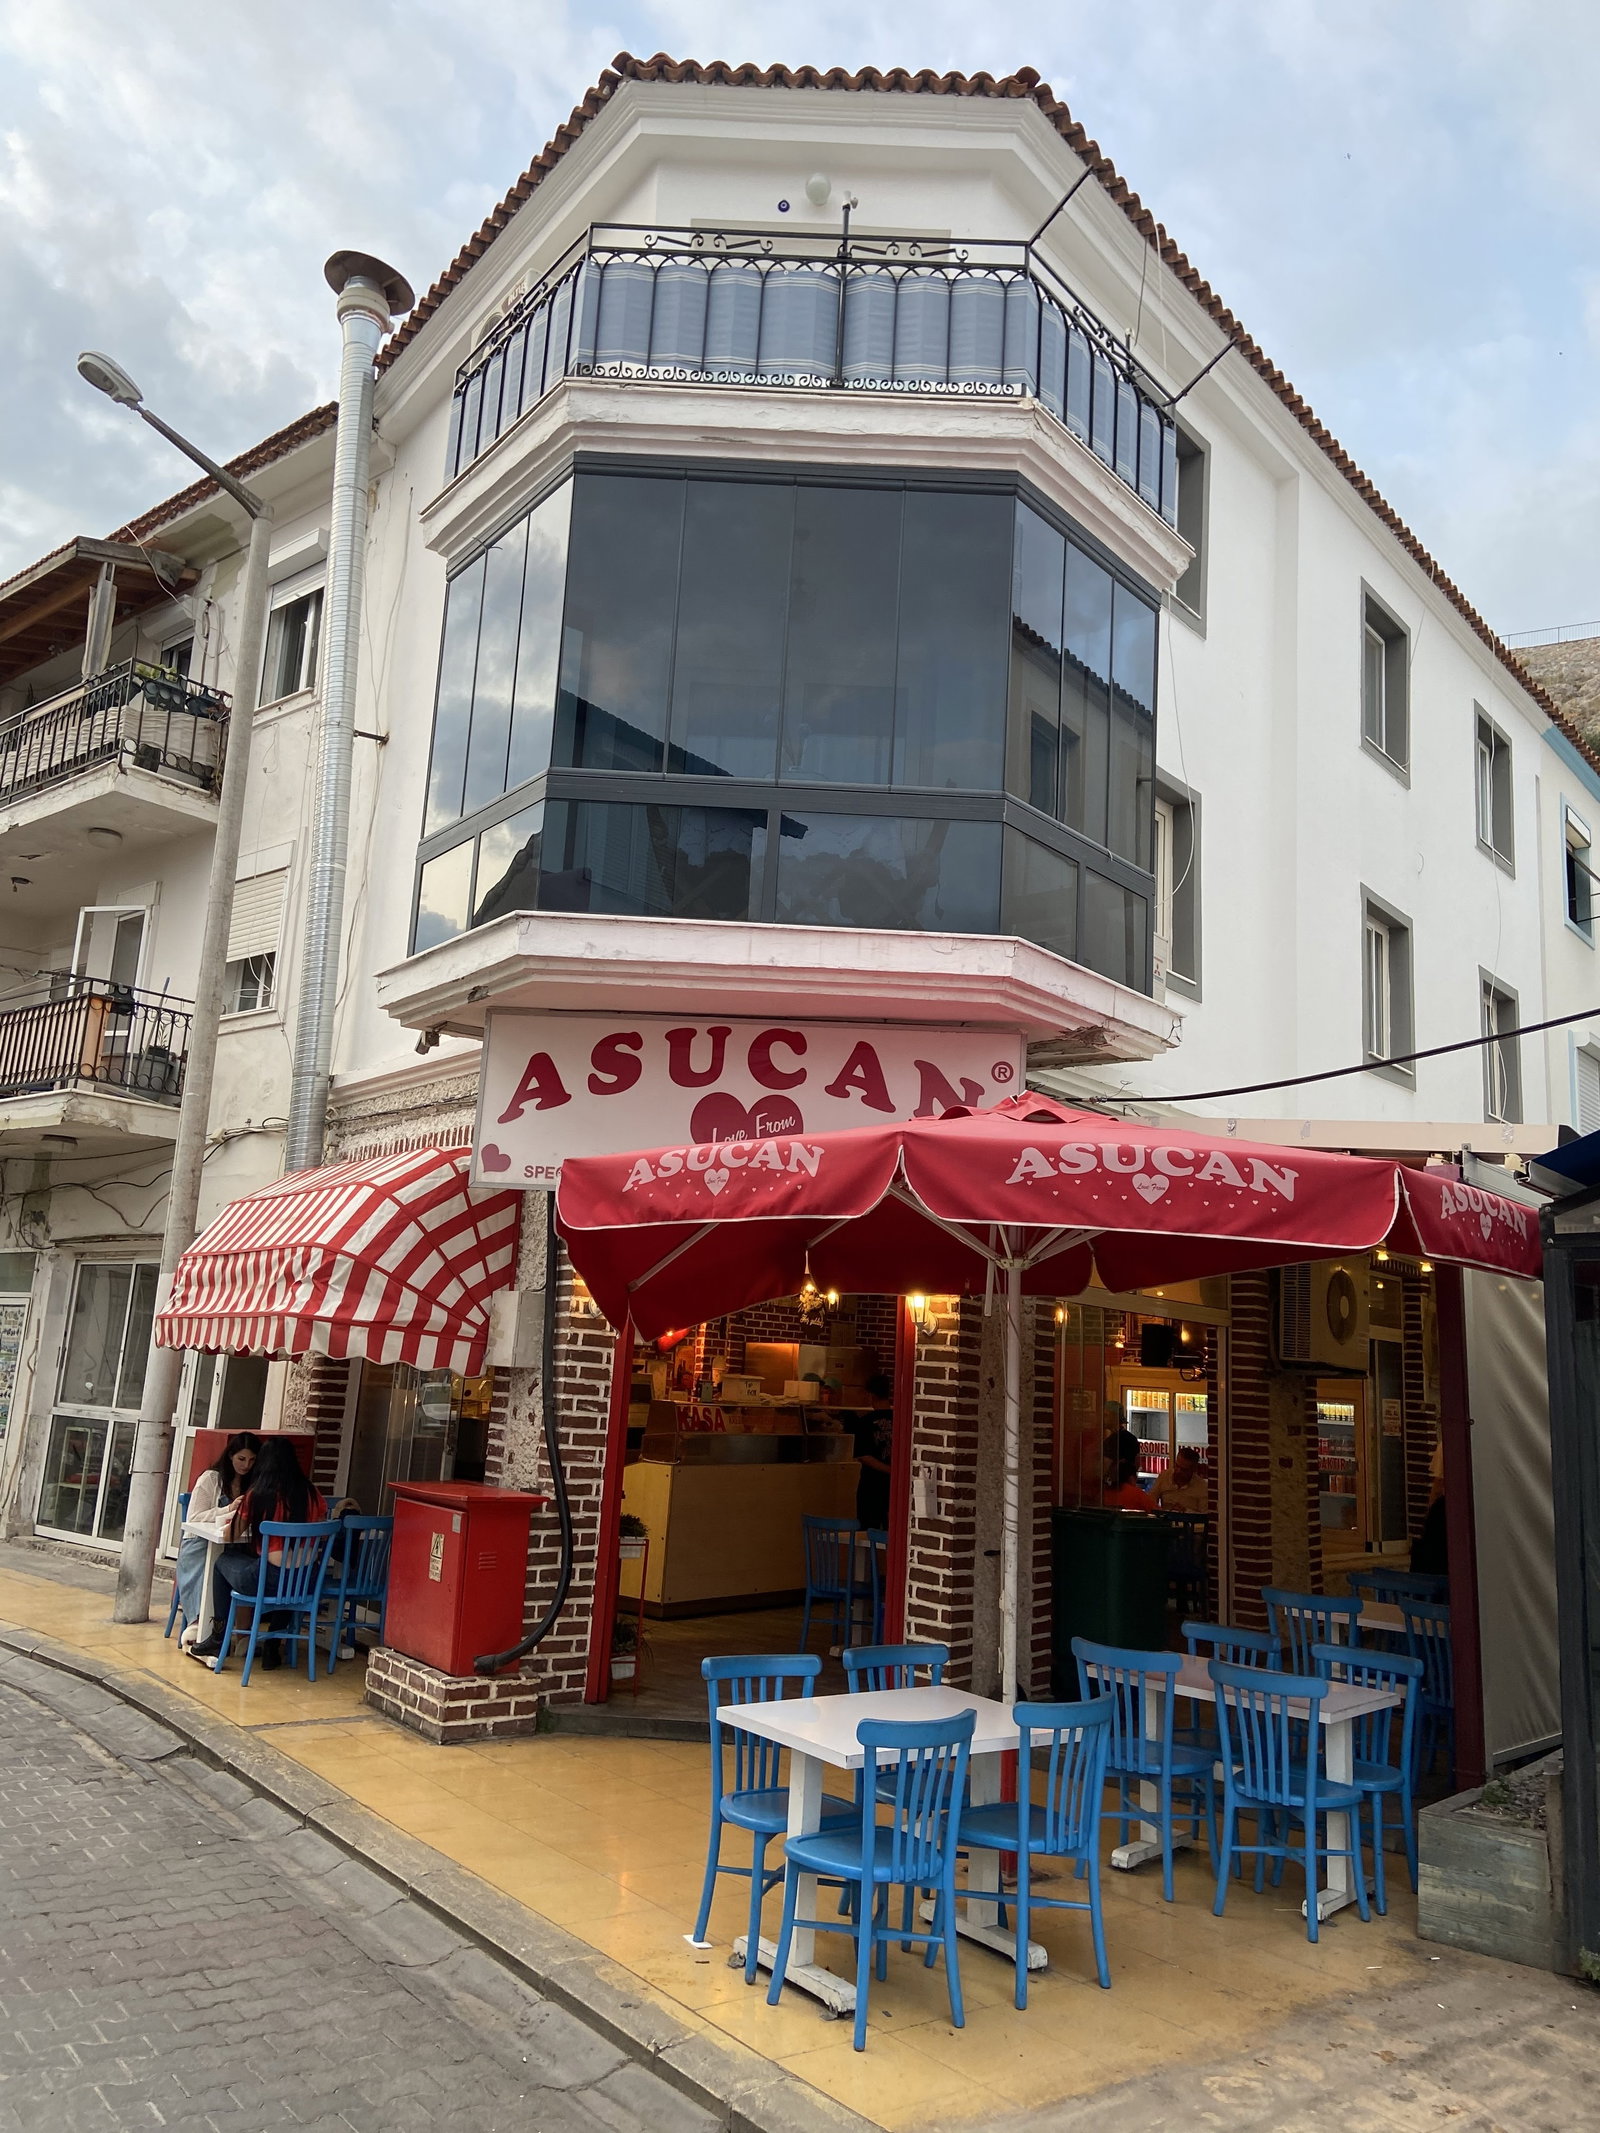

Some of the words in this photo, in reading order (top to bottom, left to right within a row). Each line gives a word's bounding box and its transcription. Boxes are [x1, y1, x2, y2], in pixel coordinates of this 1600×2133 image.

[497, 1026, 985, 1124] ASUCAN
[755, 1112, 796, 1138] From
[622, 1139, 825, 1193] ASUCAN
[1005, 1142, 1299, 1202] ASUCAN
[1440, 1184, 1529, 1239] ASUCAN
[678, 1406, 727, 1433] KASA
